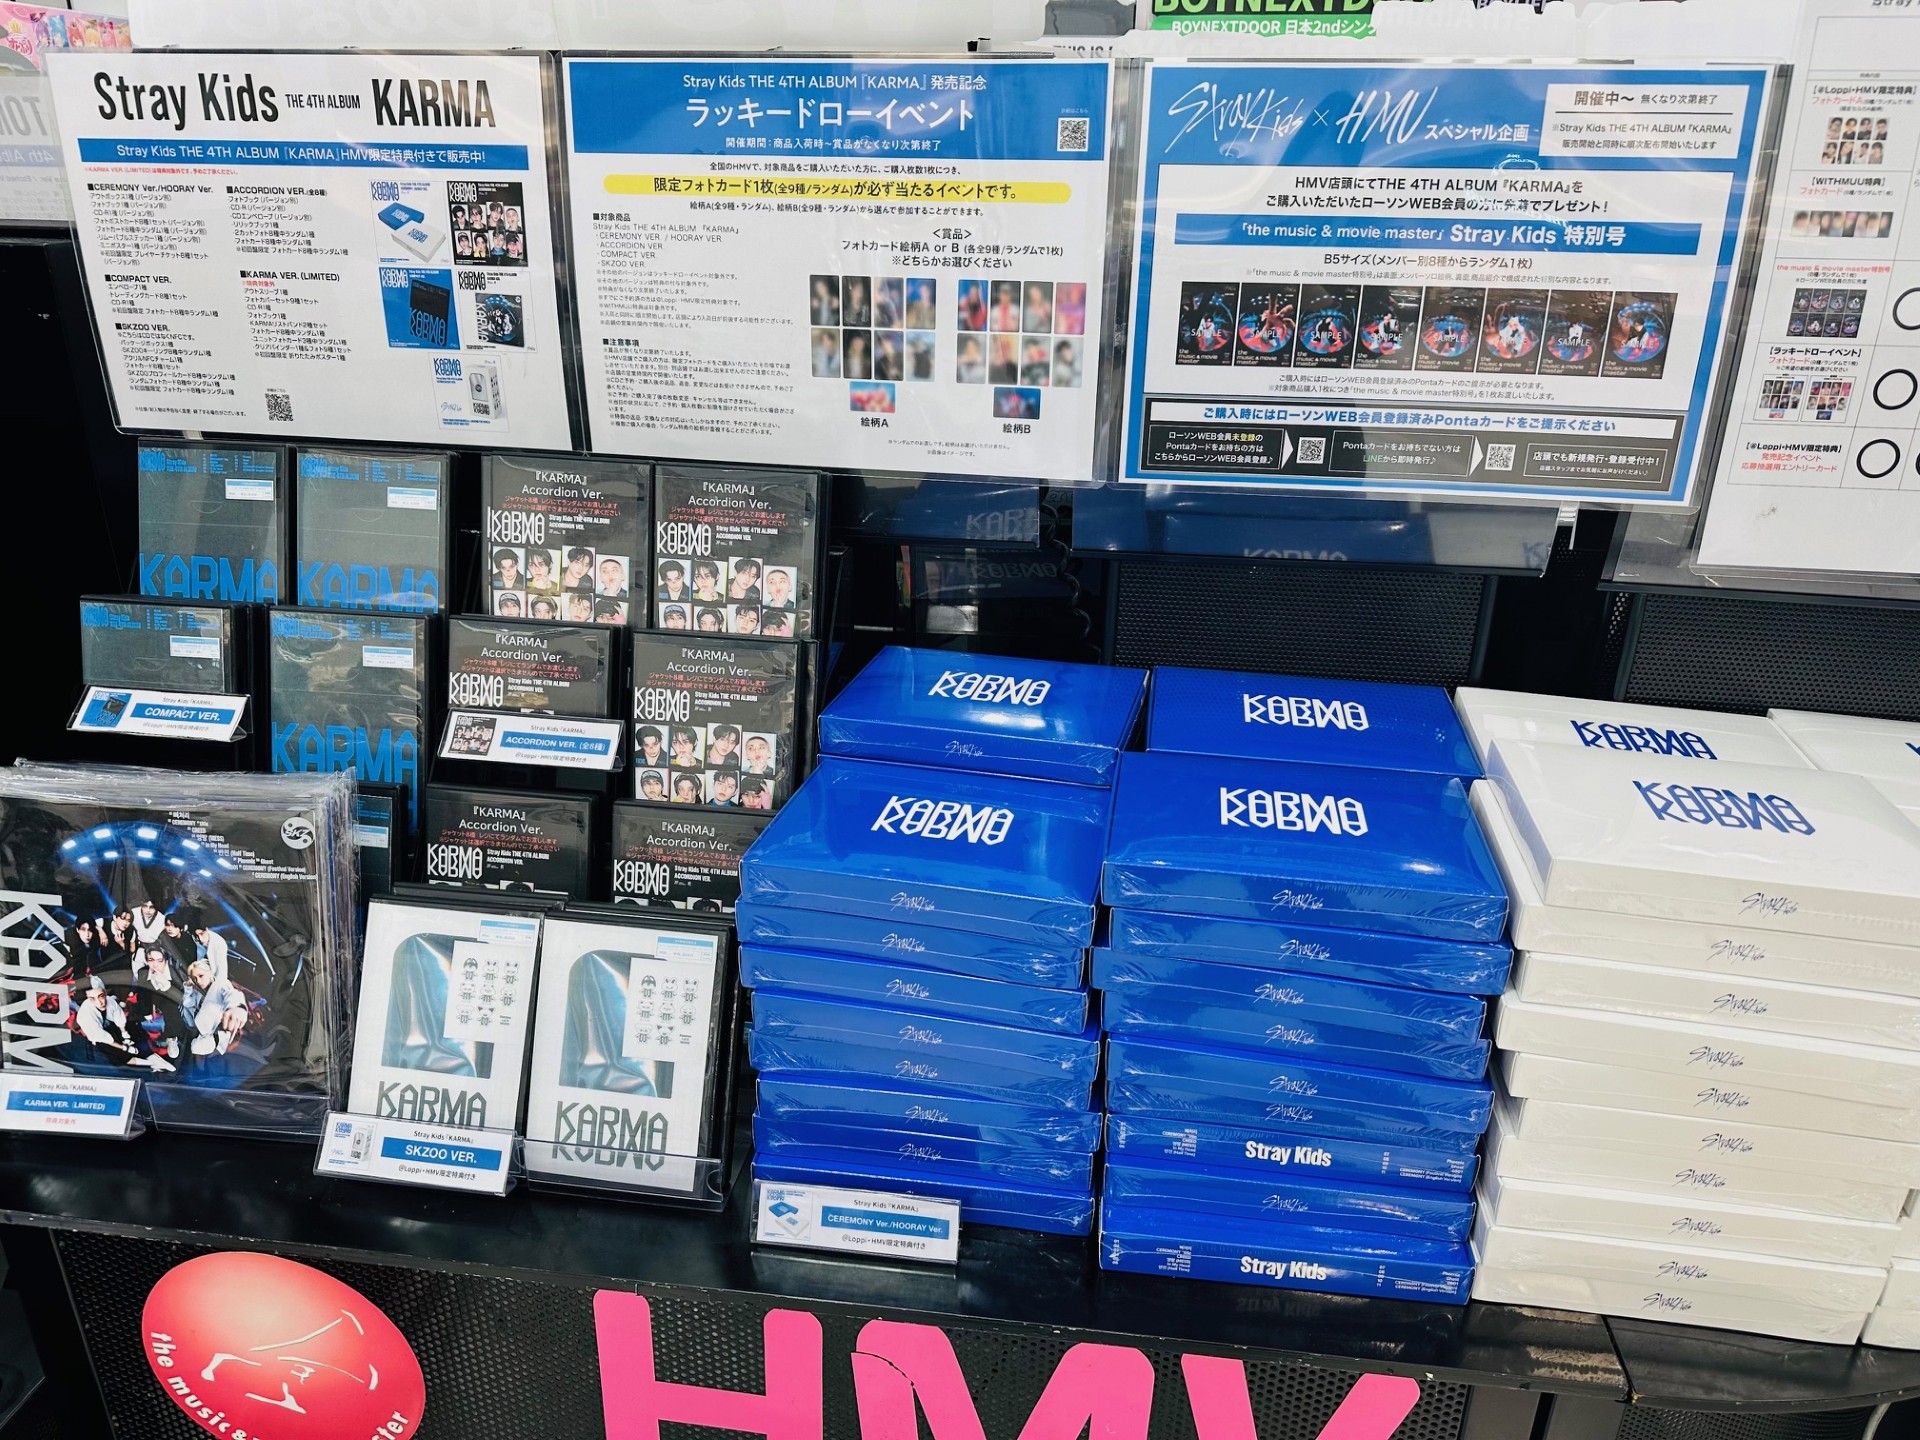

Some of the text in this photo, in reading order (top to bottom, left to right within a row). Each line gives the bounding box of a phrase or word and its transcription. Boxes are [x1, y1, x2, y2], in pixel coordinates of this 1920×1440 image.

[1172, 20, 1281, 34] BOYNEXTDOOR
[683, 75, 716, 90] Stray
[719, 75, 745, 89] Kids
[749, 75, 775, 88] THE
[779, 76, 806, 89] 4TH
[809, 76, 857, 89] ALBUM
[93, 72, 496, 131] Stray Kids THE 4TH ALBUM KARMA
[1641, 93, 1718, 105] 無くなり次第終了
[686, 98, 973, 131] ラッキードローイベント
[1335, 86, 1439, 144] HMV
[1425, 123, 1530, 143] スペシャル企画
[1586, 123, 1606, 133] Kids
[1608, 124, 1627, 133] THE
[1629, 124, 1649, 133] 4TH
[1651, 124, 1686, 133] ALBUM
[117, 145, 147, 158] Stray
[151, 145, 176, 157] Kids
[179, 146, 204, 158] THE
[207, 147, 231, 158] 4TH
[236, 147, 279, 159] ALBUM
[234, 186, 285, 194] ACCORDION
[654, 177, 1016, 199] 限定フォトカード1枚(全9種/ランダム)が必ず当たるイベントです。
[1295, 176, 1406, 191] HMV店頭にてTHE
[1410, 179, 1441, 191] 4TH
[1445, 179, 1498, 192] ALBUM
[600, 213, 631, 221] 対象商品
[593, 223, 612, 231] Stray
[600, 232, 704, 242] CEREMONY HOORAY
[1274, 224, 1316, 238] music
[1321, 225, 1332, 238] &
[1337, 226, 1381, 239] movie
[1450, 224, 1507, 246] Stray
[1511, 225, 1557, 245] Kids
[1564, 226, 1627, 246] 特別号
[842, 240, 930, 253] フォトカード絵柄A
[934, 244, 947, 253] or
[951, 243, 959, 253] B
[892, 256, 1012, 268] ※どちらかお選びください
[111, 275, 150, 283] COMPACT
[246, 271, 339, 282] KARMA VER. (LIMITED)
[609, 338, 640, 347] 注意事項
[1310, 331, 1342, 340] SAMPLE
[1557, 338, 1591, 347] SAMPLE
[860, 417, 889, 429] 絵柄A
[1204, 407, 1616, 432] ご購入時にはローソンWEB会員登録済みPontaカードをご提示ください
[1002, 423, 1031, 434] 絵柄B
[1168, 432, 1263, 442] ローソンWEB会員未登録の
[1166, 442, 1264, 453] Pontaカードをお持ちの方は
[1342, 441, 1461, 453] Pontaカードをお持ちでない方は
[1761, 453, 1822, 463] 発売記念イベント
[522, 485, 604, 500] Accordion Ver.
[688, 496, 772, 510] Accordion Ver.
[139, 552, 278, 605] KARMA
[297, 559, 439, 614] KARMA
[481, 647, 565, 663] Accordion Ver.
[667, 662, 752, 677] Accordion Ver.
[145, 707, 221, 721] COMPACT VER.
[506, 736, 556, 747] ACCORDION
[559, 739, 576, 748] VER.
[272, 722, 417, 788] KARMA
[72, 1102, 105, 1111] (LIMITED)
[377, 1080, 487, 1130] KARMA
[414, 1131, 430, 1140] Stray
[431, 1132, 445, 1140] Kids
[405, 1144, 477, 1163] SKZOO VER.
[1245, 1140, 1332, 1167] Stray Kids
[827, 1214, 943, 1234] CEREMONY Ver./HOORAY Ver.
[1240, 1256, 1327, 1281] Stray Kids
[151, 1331, 231, 1433] the music
